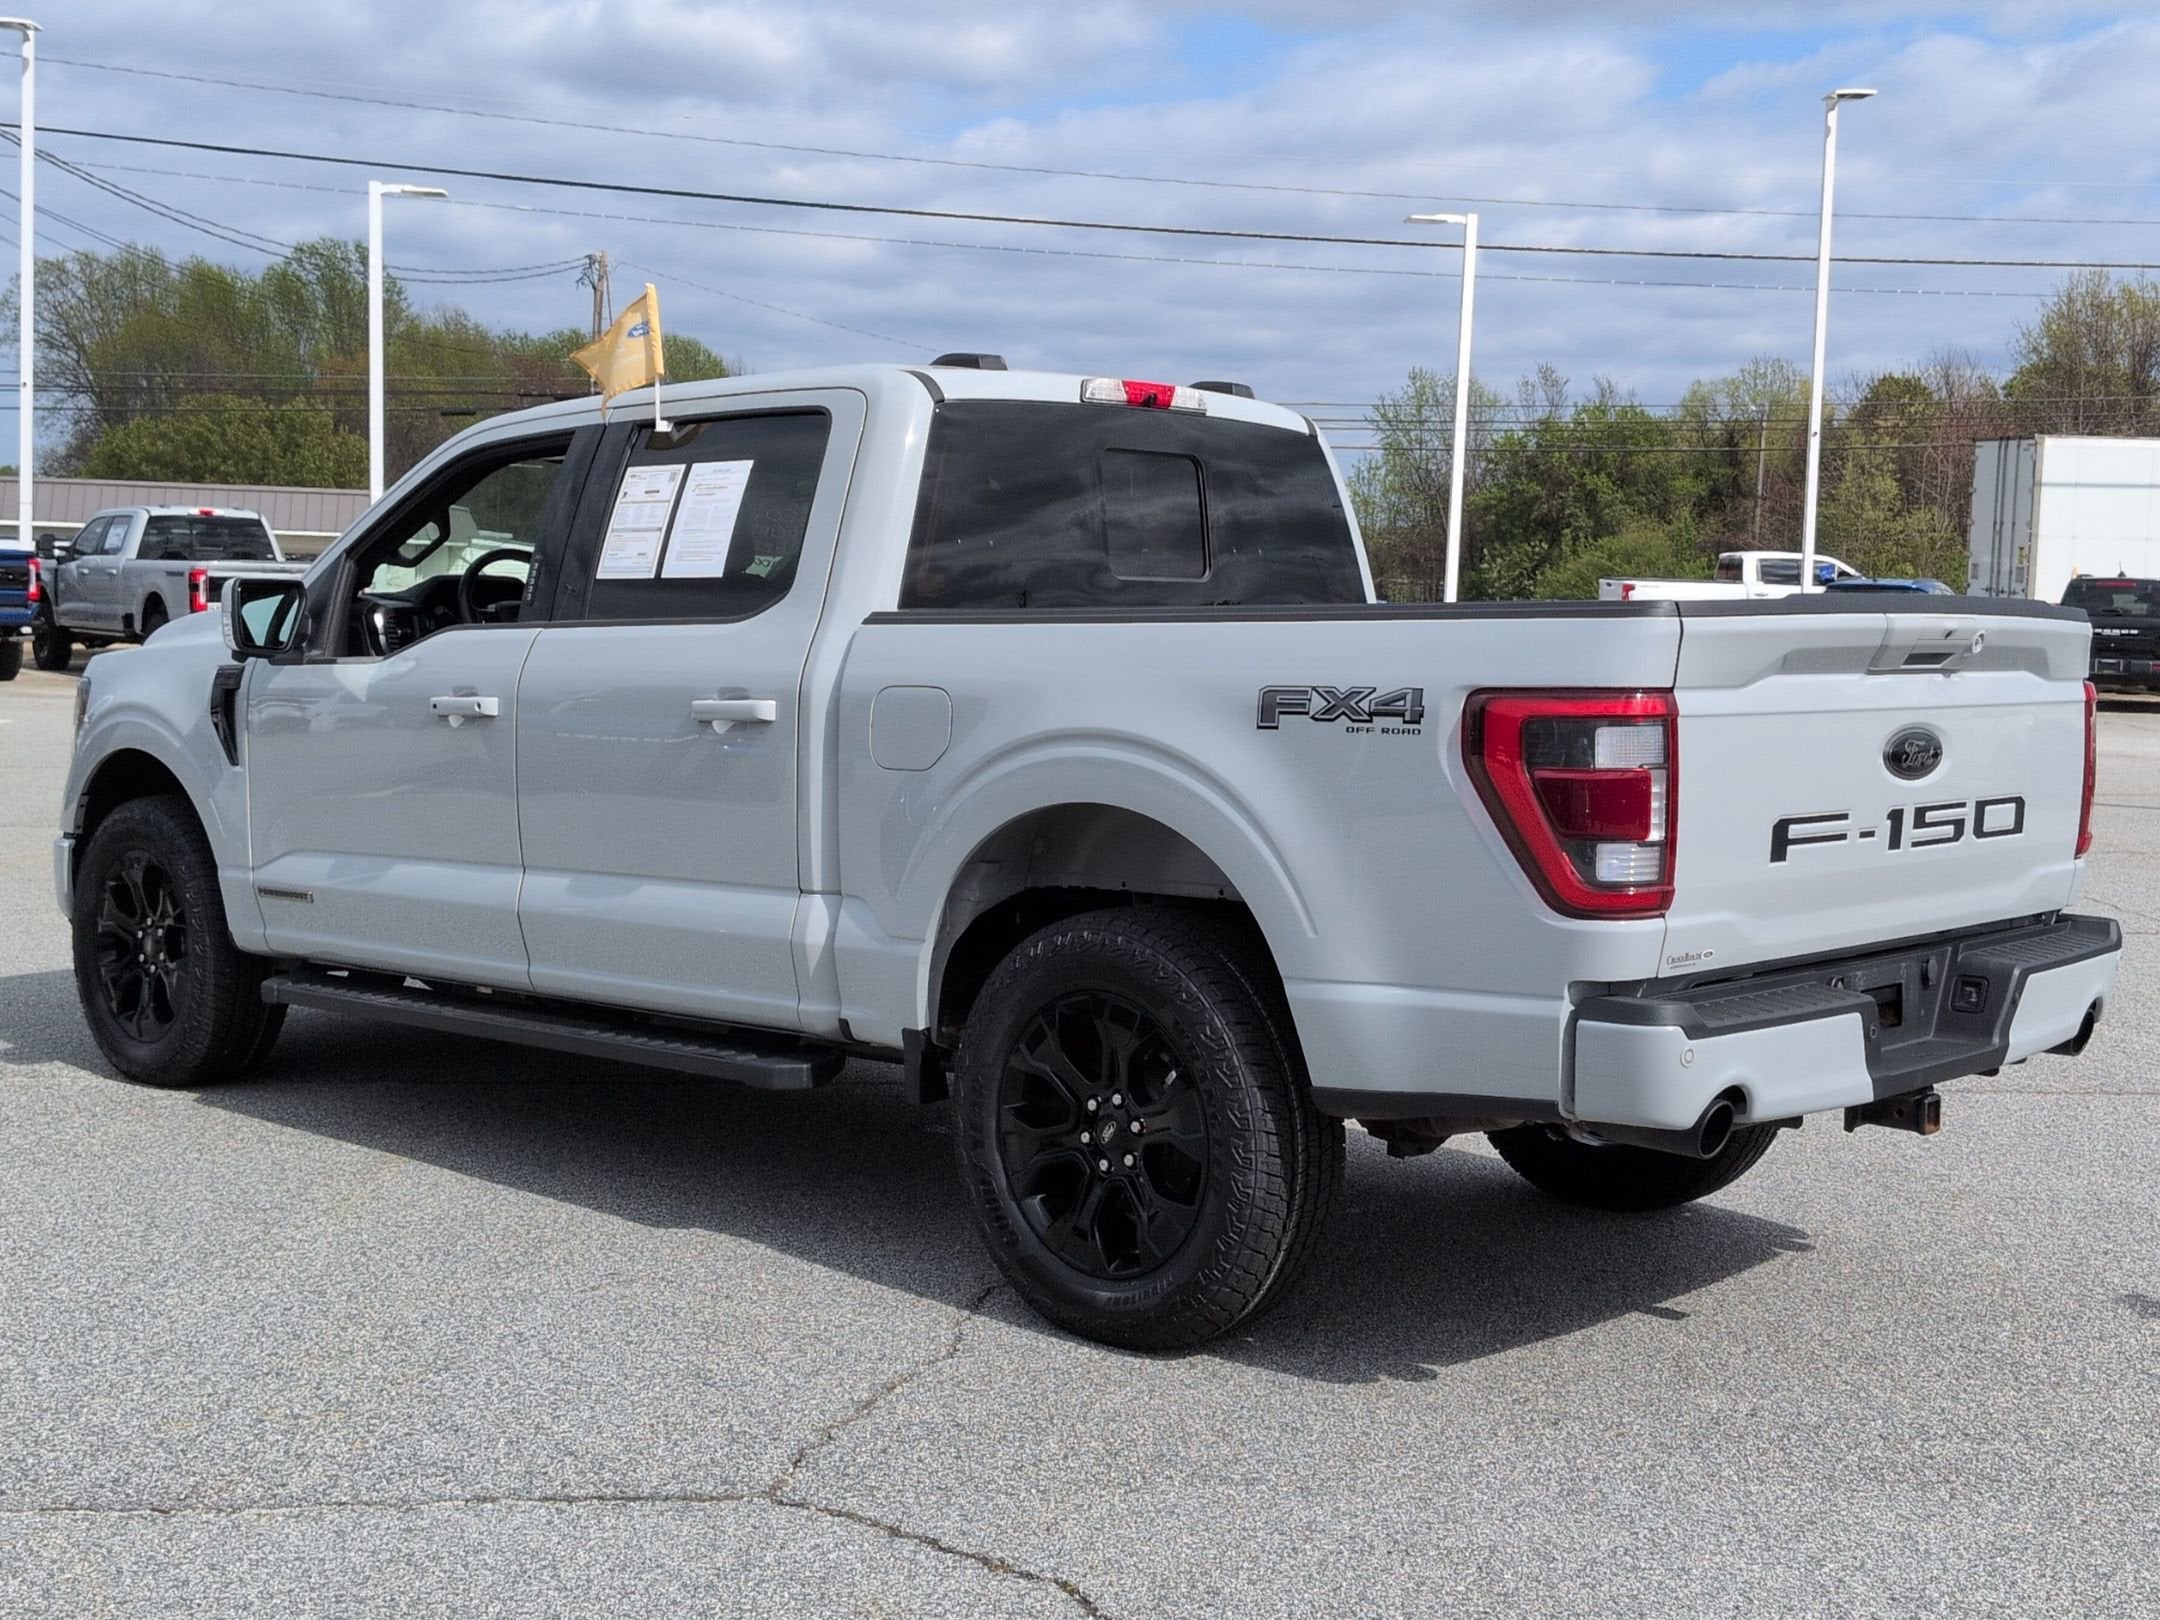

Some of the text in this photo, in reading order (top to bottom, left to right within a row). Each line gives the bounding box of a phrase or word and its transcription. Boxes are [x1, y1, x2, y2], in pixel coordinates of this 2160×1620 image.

[1256, 685, 1425, 730] FX4
[1345, 726, 1422, 736] OFF ROAD
[1769, 795, 2026, 864] F-150
